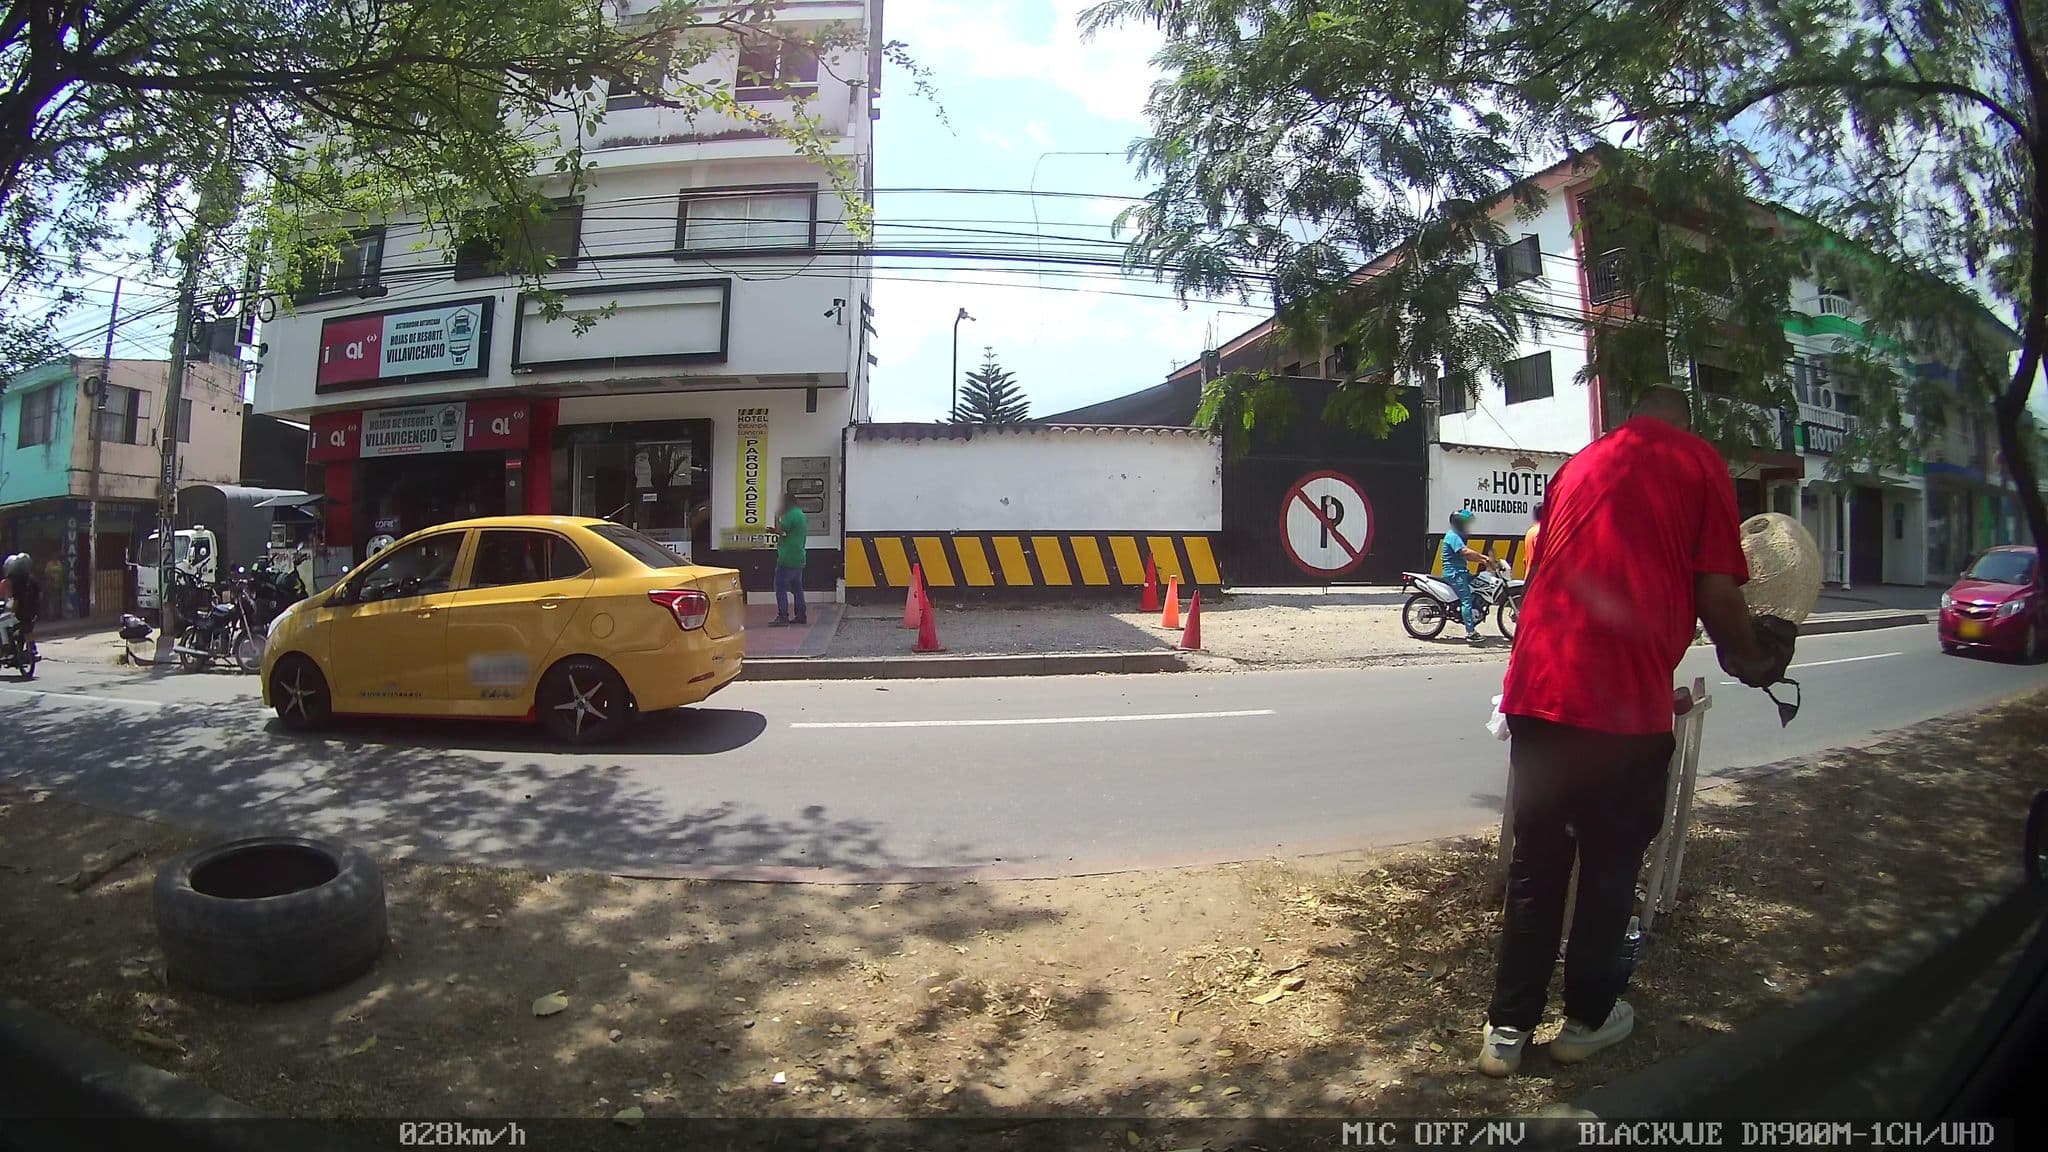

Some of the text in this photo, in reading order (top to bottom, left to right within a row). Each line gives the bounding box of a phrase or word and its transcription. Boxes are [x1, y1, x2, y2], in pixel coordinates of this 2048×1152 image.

[417, 330, 443, 343] RESORTE
[386, 343, 445, 364] VILLAVICENCIO
[402, 415, 434, 428] RESORTE
[737, 415, 769, 423] HOTEL
[365, 429, 437, 448] VILLAVICENCIO
[744, 439, 759, 524] PARQUEADERO
[1463, 497, 1528, 515] PARQUEADERO
